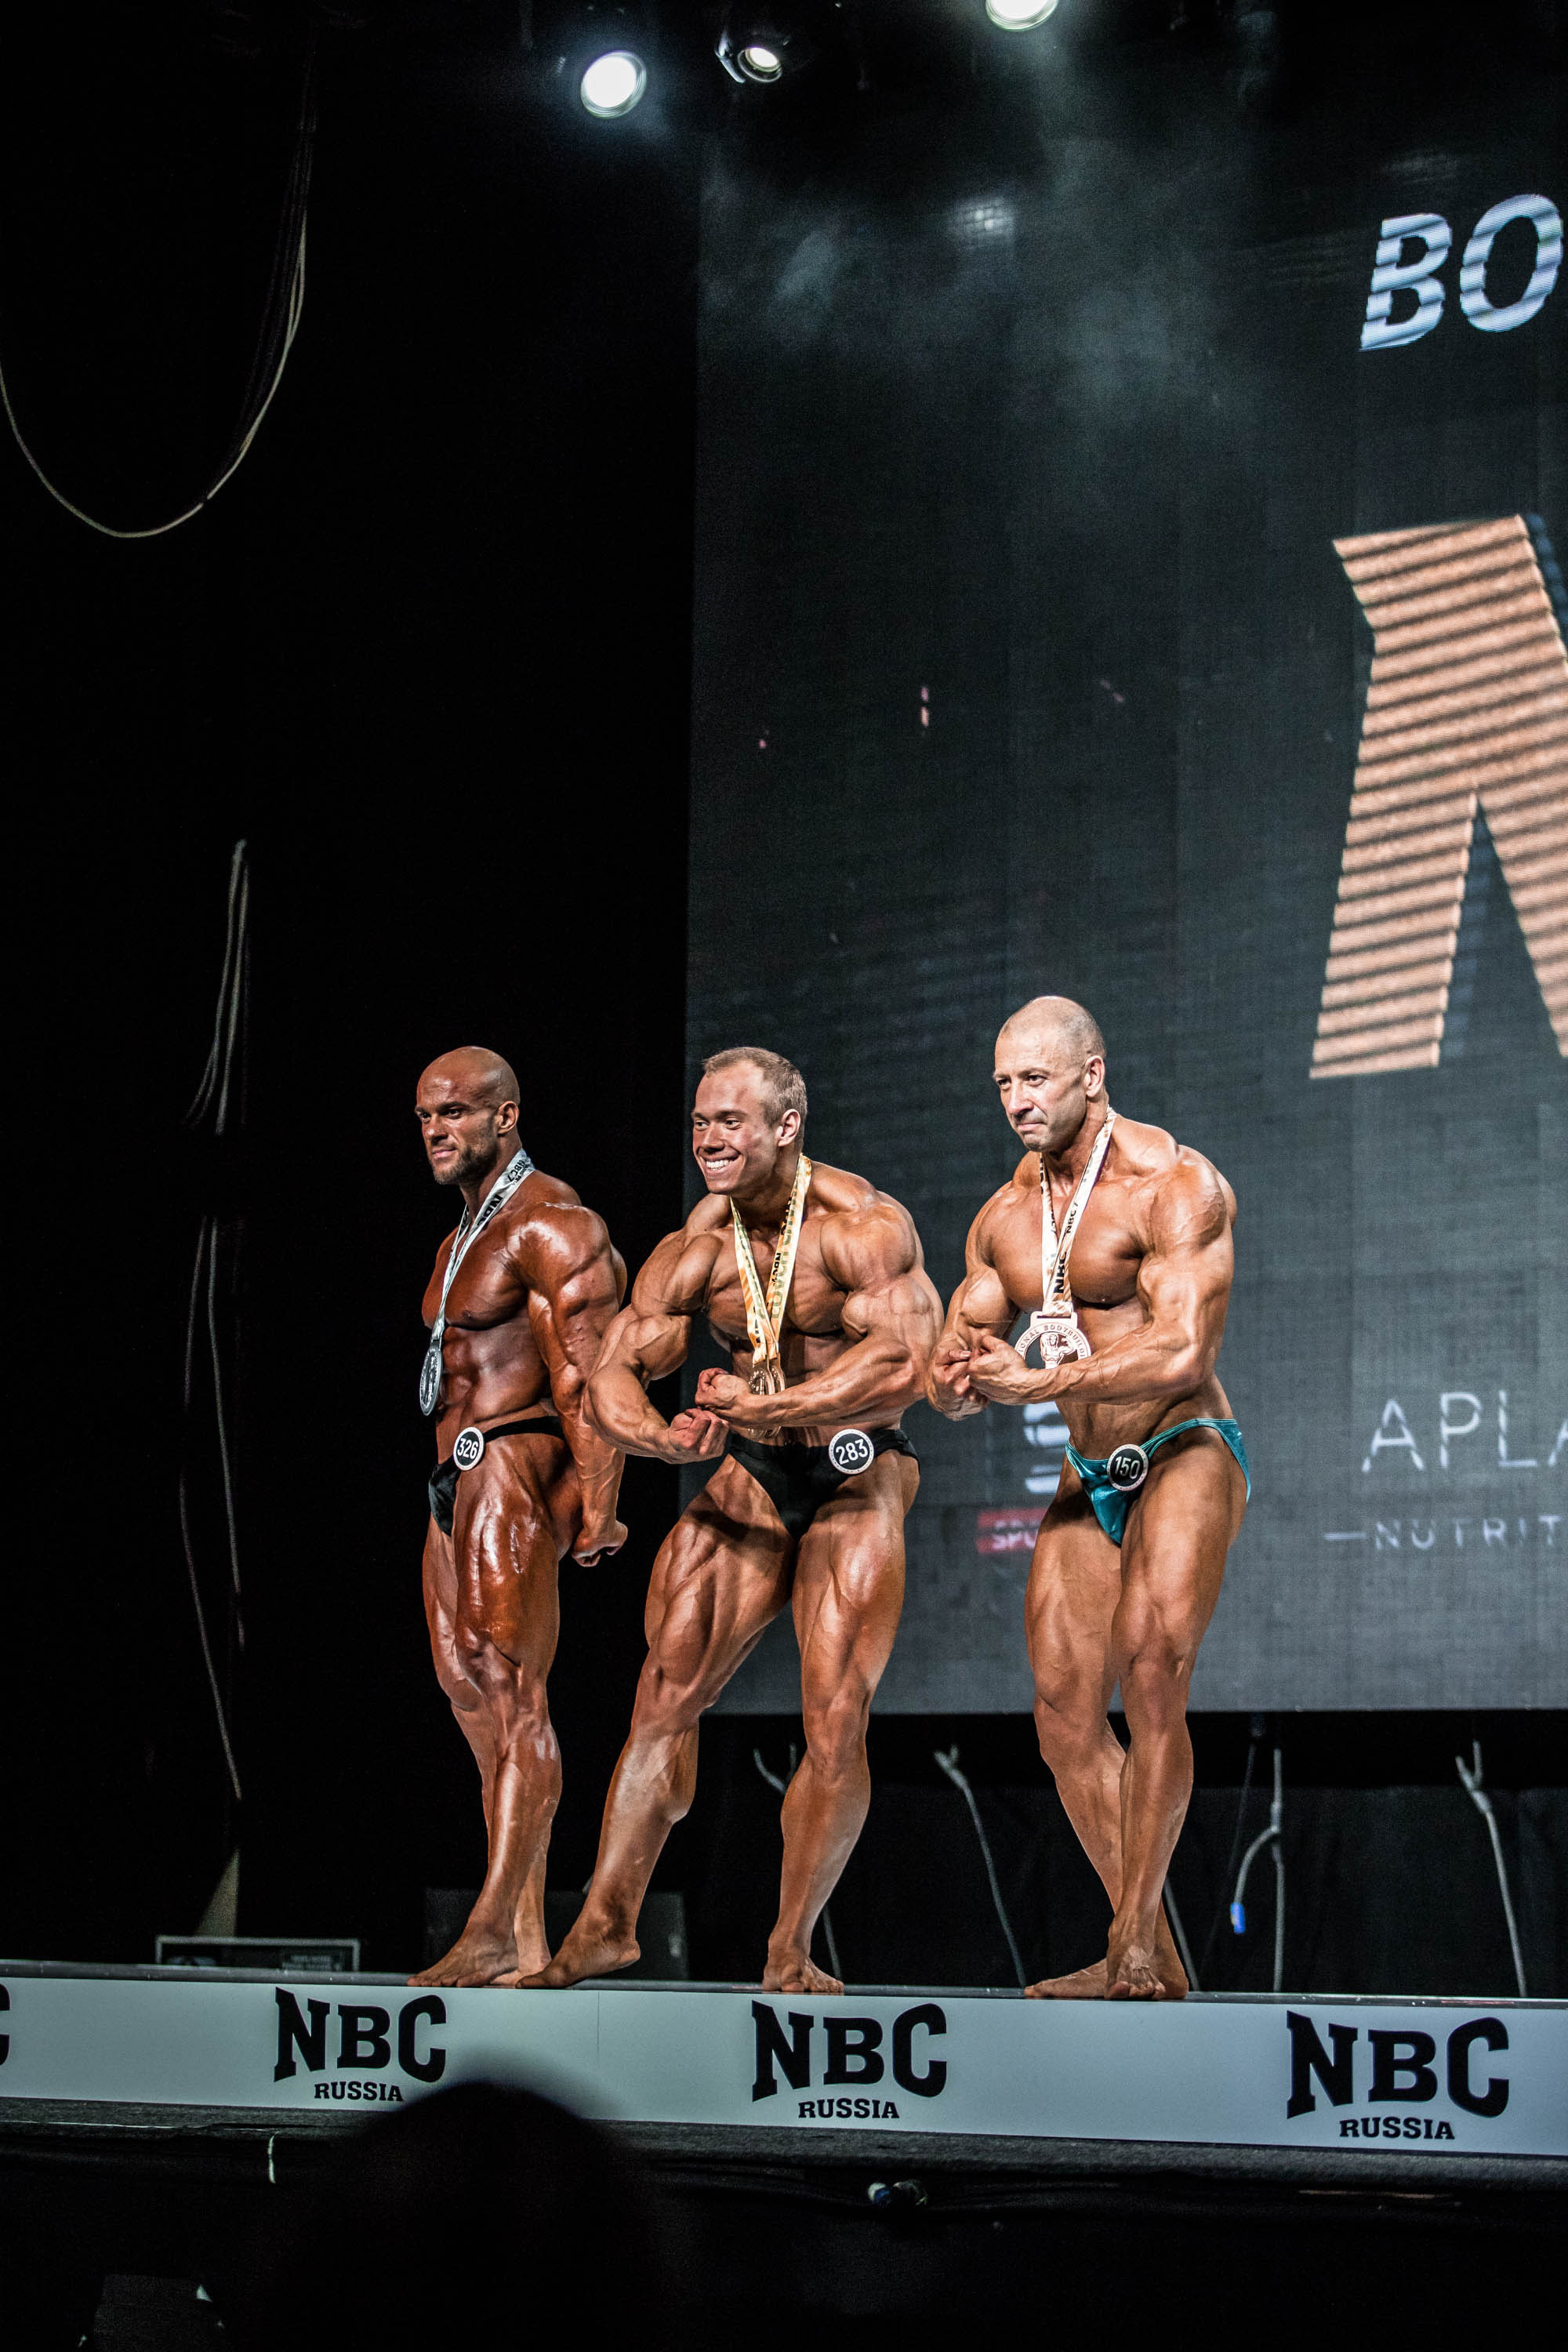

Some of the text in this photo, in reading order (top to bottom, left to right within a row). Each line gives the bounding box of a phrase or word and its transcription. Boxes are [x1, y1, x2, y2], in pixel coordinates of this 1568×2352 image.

[1359, 194, 1563, 352] BO
[457, 1438, 479, 1460] 326
[835, 1438, 869, 1465] 283
[1115, 1456, 1141, 1480] 150
[274, 1987, 447, 2083] NBC
[752, 2000, 947, 2102] NBC
[1287, 2010, 1509, 2119] NBC
[314, 2082, 404, 2102] RUSSIA
[798, 2098, 900, 2119] RUSSIA
[1339, 2117, 1455, 2140] RUSSIA
